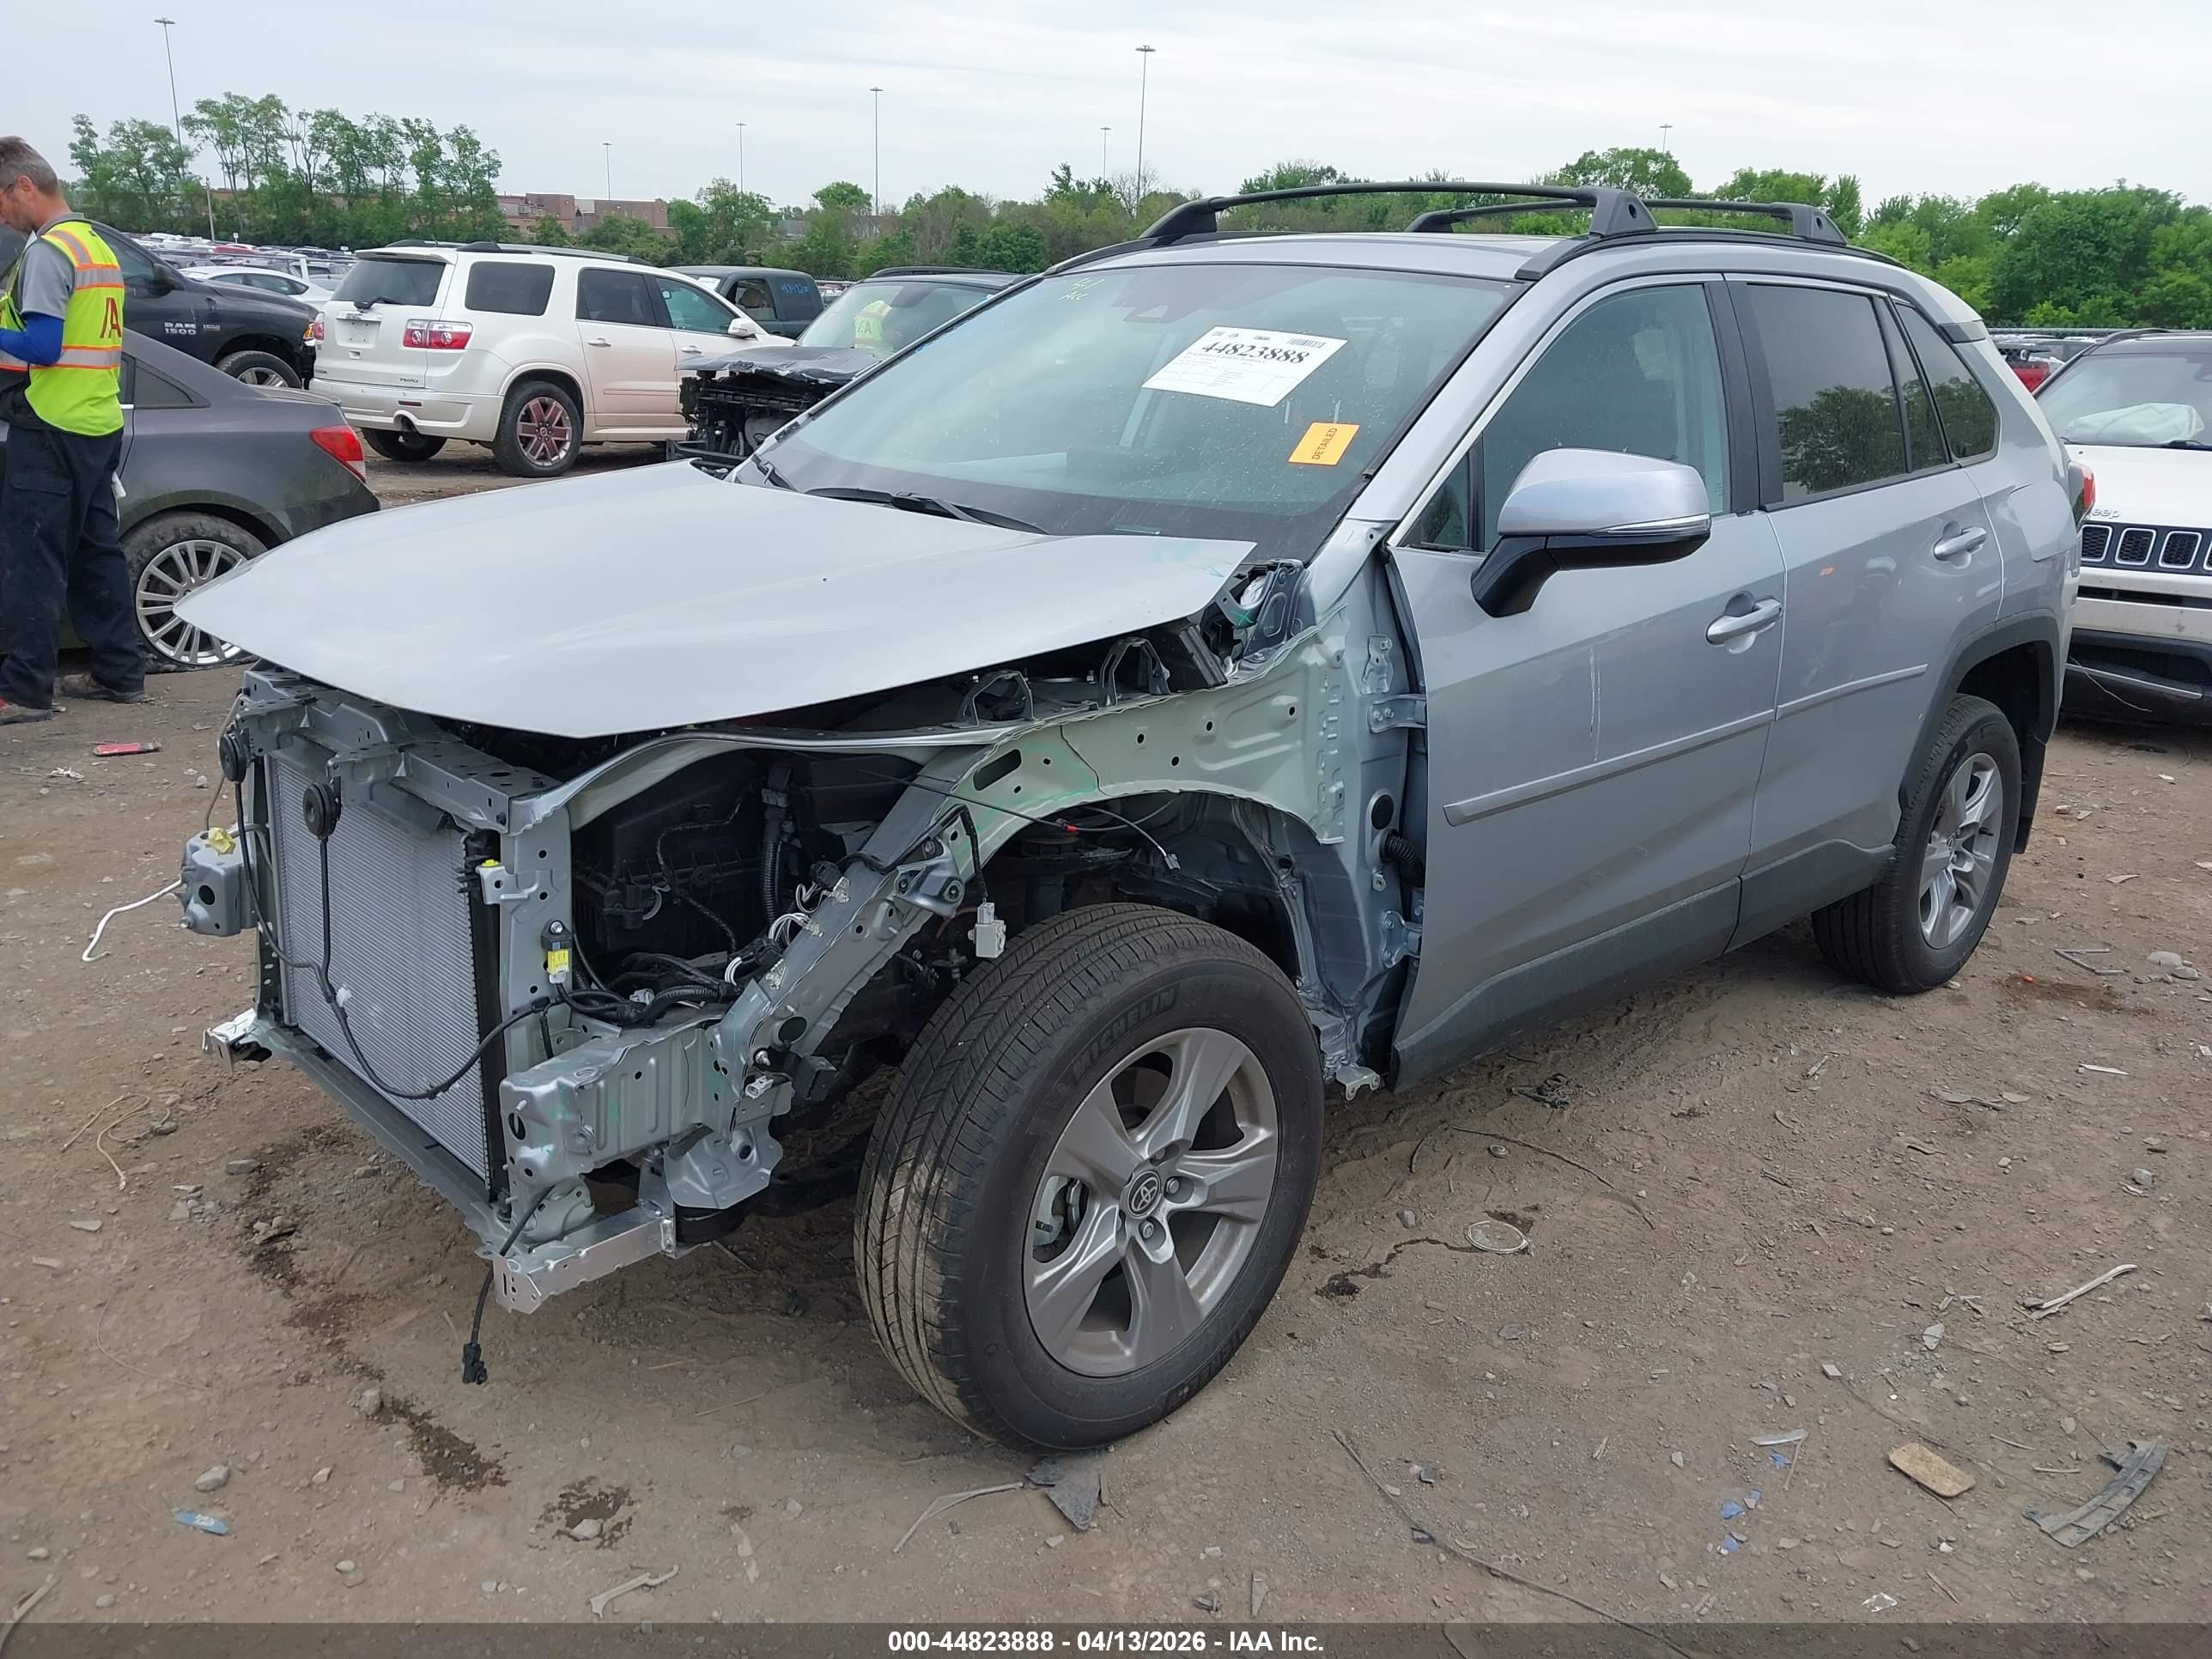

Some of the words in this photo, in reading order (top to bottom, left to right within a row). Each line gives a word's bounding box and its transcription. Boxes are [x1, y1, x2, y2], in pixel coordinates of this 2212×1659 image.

[1202, 341, 1310, 364] 44823888
[1311, 428, 1338, 460] DETAILED
[2087, 508, 2121, 520] eep
[1072, 988, 1176, 1079] MICHELIN
